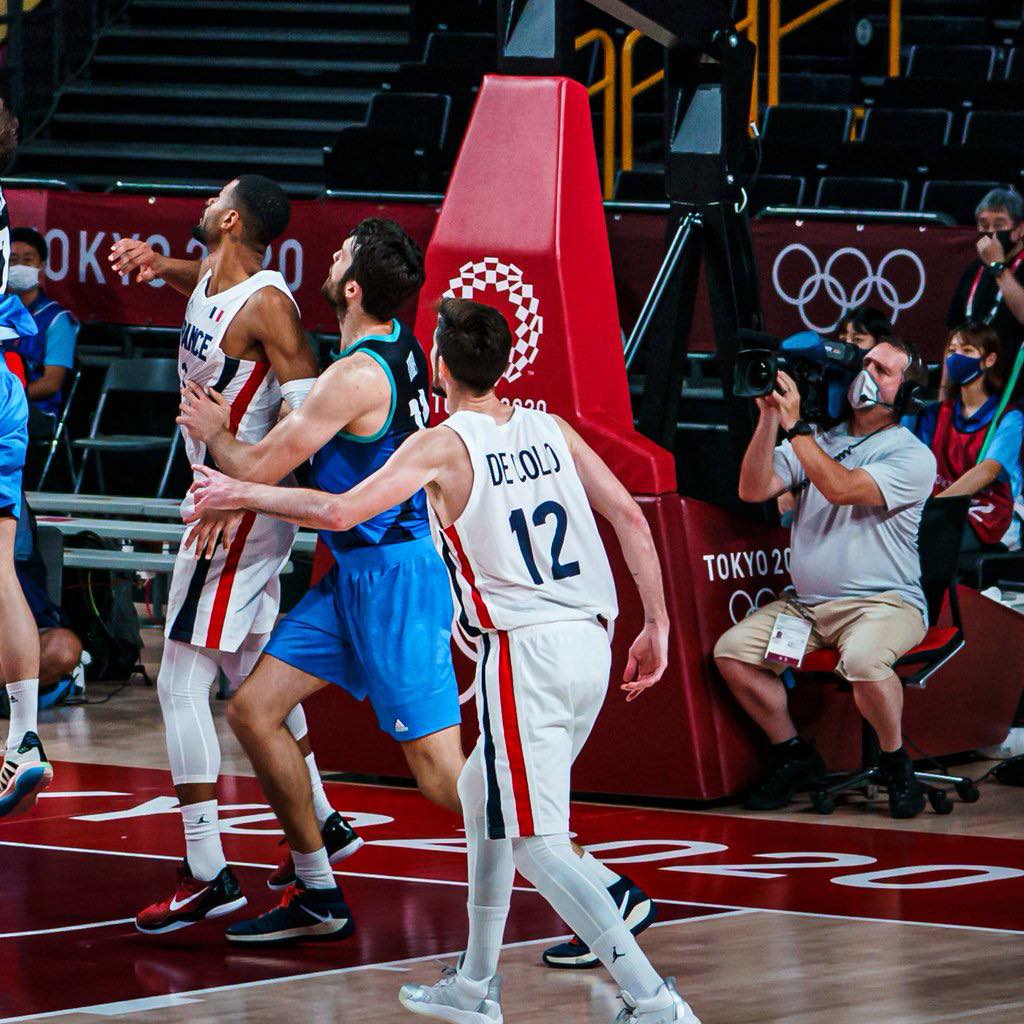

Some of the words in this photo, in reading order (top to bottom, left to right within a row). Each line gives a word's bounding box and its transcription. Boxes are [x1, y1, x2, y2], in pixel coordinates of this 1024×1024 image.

[181, 320, 214, 363] ANCE
[486, 452, 514, 487] DE
[509, 500, 581, 586] 12
[702, 550, 768, 582] TOKYO
[772, 547, 791, 575] 20
